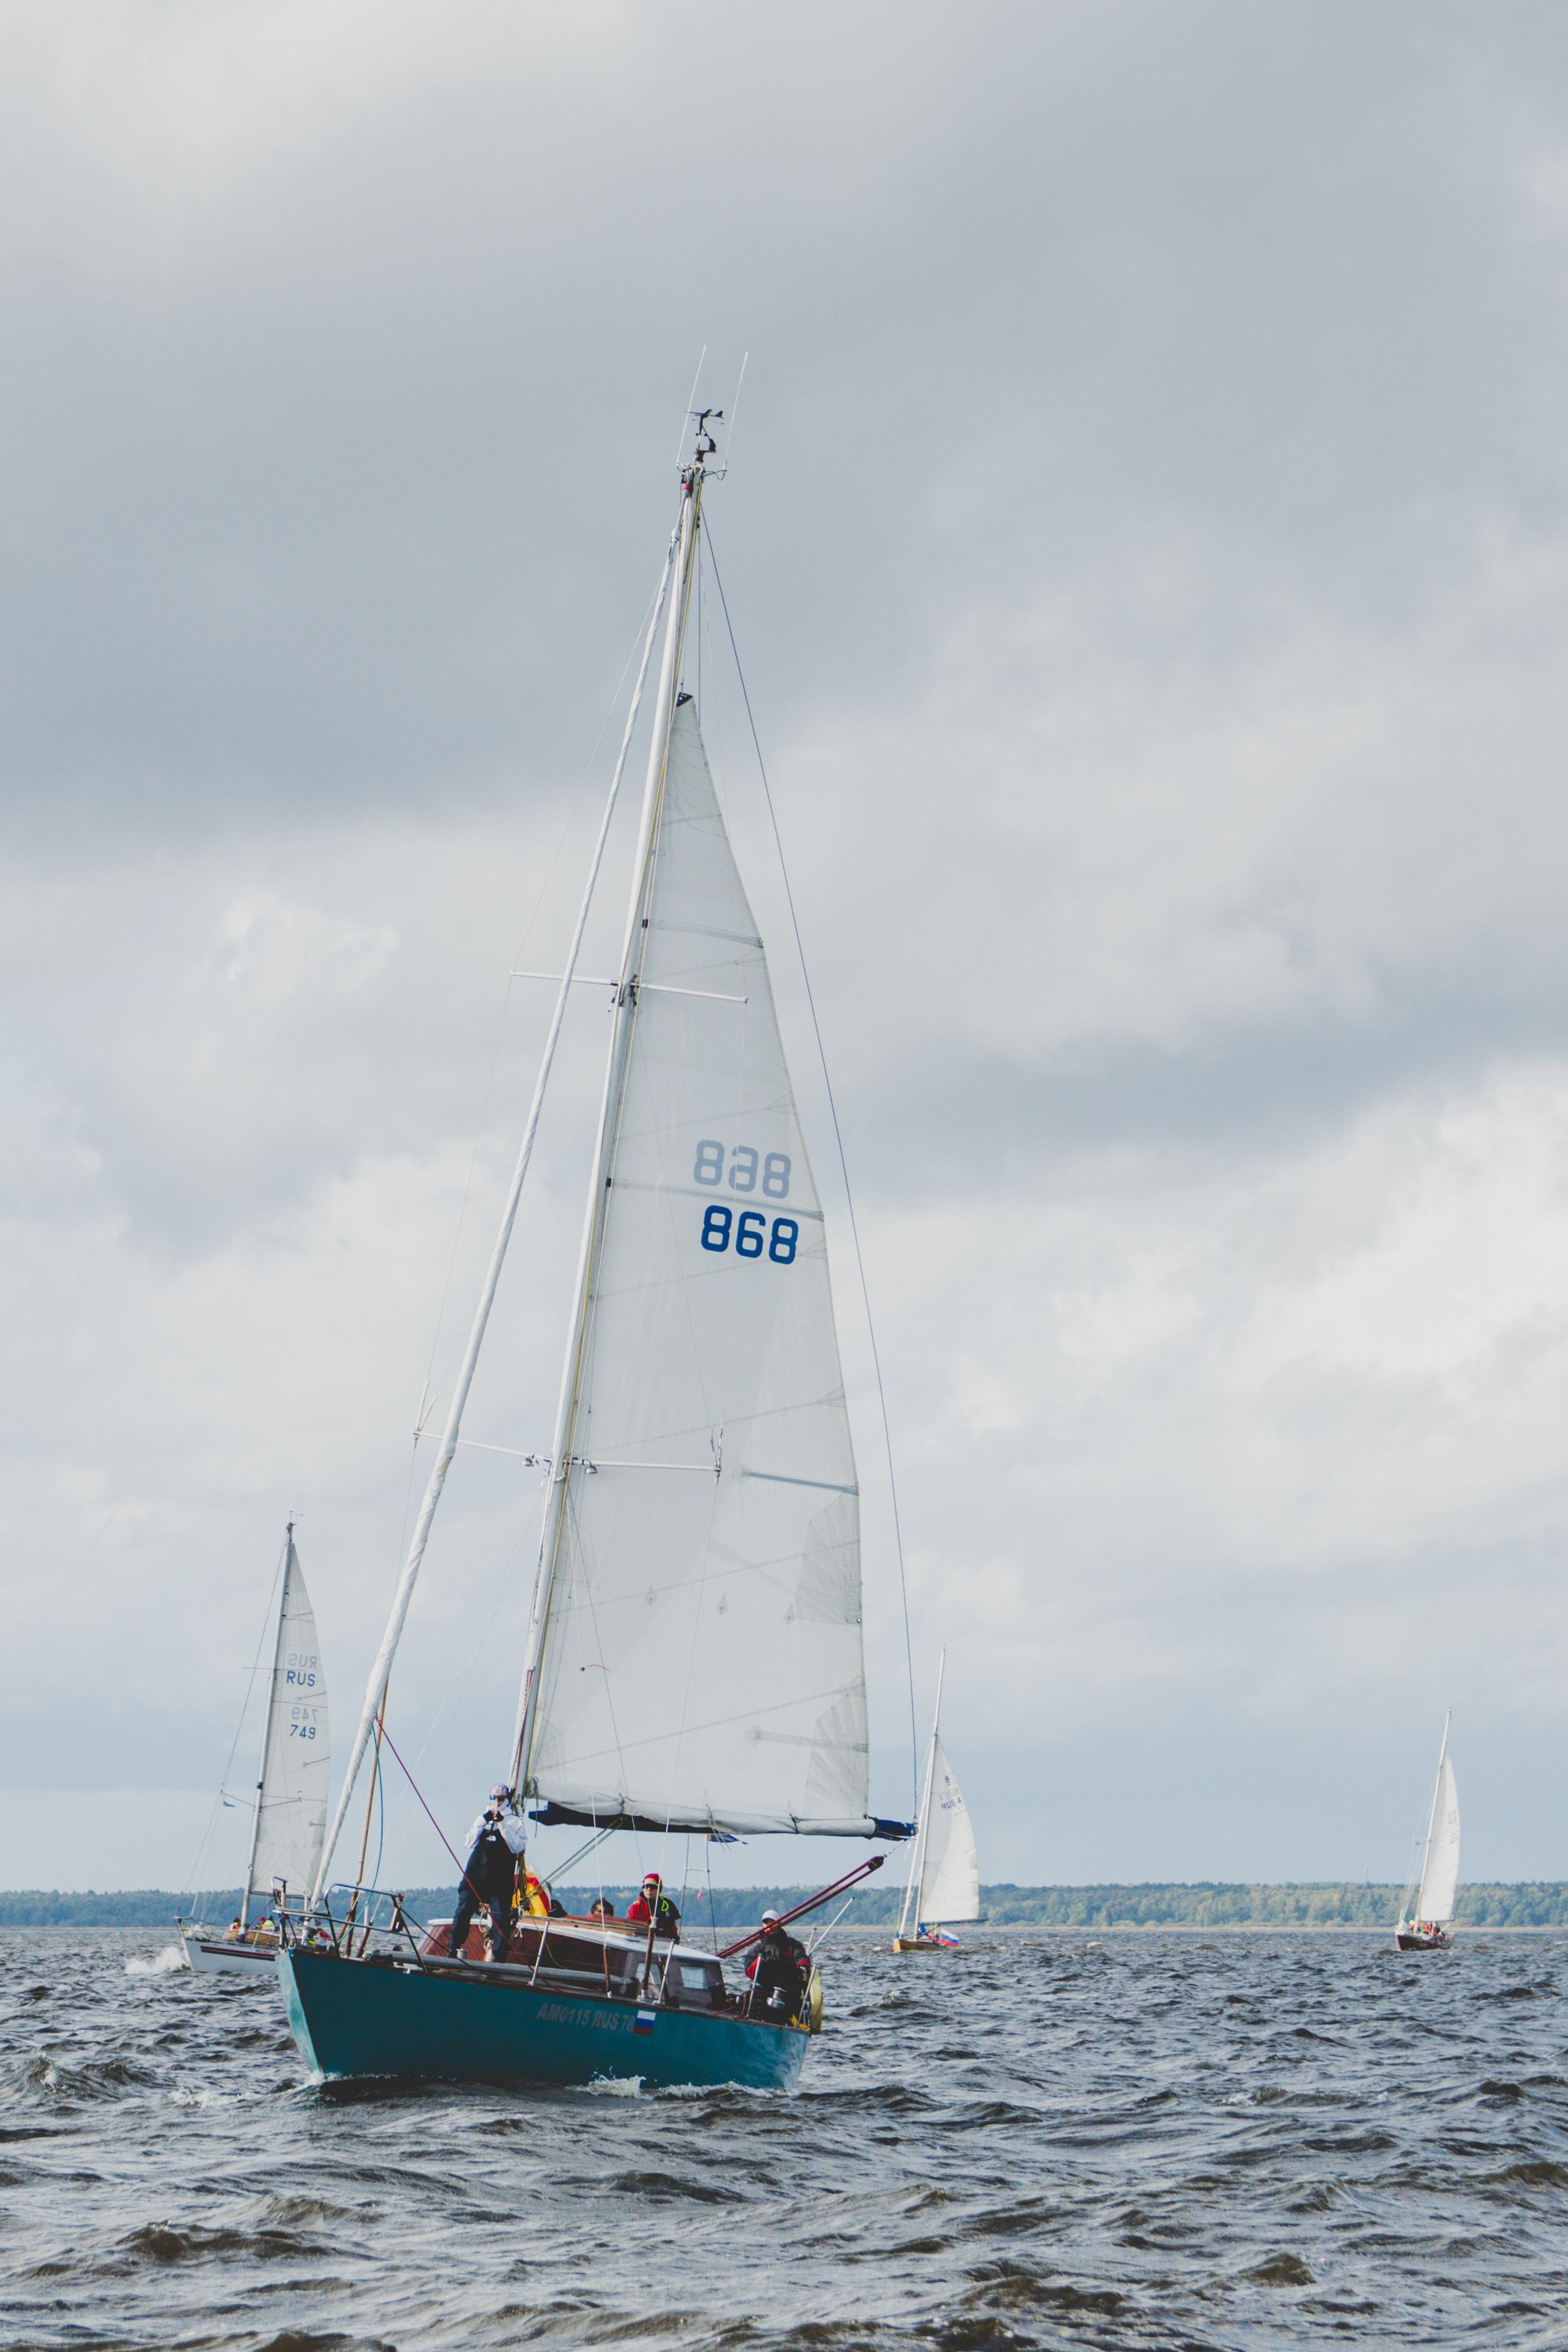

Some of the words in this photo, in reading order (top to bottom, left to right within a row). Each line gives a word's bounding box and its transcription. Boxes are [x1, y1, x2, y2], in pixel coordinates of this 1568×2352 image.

[701, 1205, 799, 1265] 868
[286, 1670, 315, 1687] RUS
[290, 1724, 316, 1740] 749
[941, 1799, 956, 1810] RUS
[591, 2010, 620, 2030] RUS
[620, 2014, 636, 2032] 78
